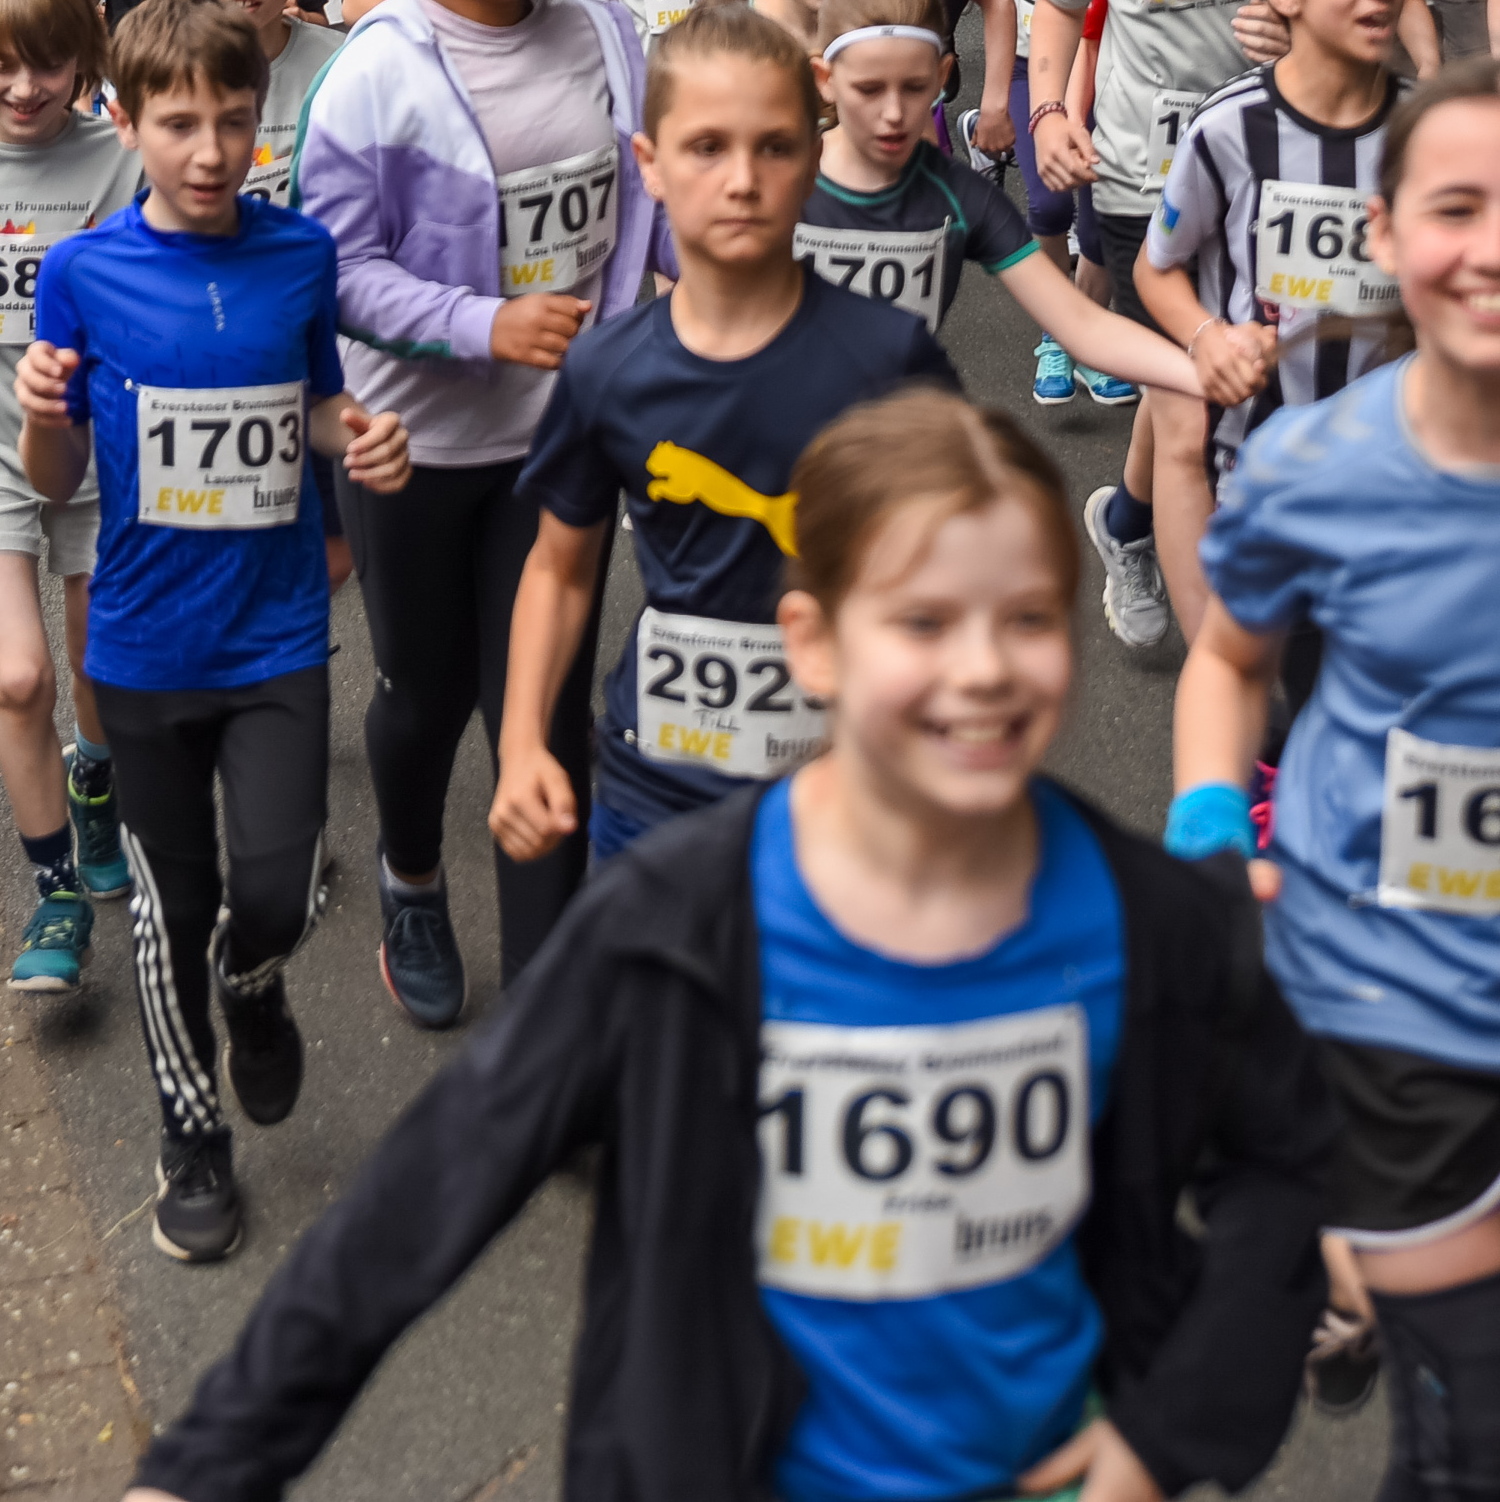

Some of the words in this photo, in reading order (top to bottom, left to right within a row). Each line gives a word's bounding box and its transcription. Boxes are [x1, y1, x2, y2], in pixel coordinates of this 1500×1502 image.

[15, 200, 91, 213] Brunnenlauf
[499, 169, 615, 248] 1707
[1266, 209, 1373, 263] 168
[1269, 273, 1334, 303] EWE
[1328, 265, 1356, 277] Lina
[151, 398, 227, 412] Everstener
[147, 409, 300, 469] 1703
[156, 486, 226, 515] EWE
[646, 644, 820, 713] 292
[657, 722, 734, 760] EWE
[760, 1064, 1073, 1183] 1690
[769, 1215, 903, 1274] EWE
